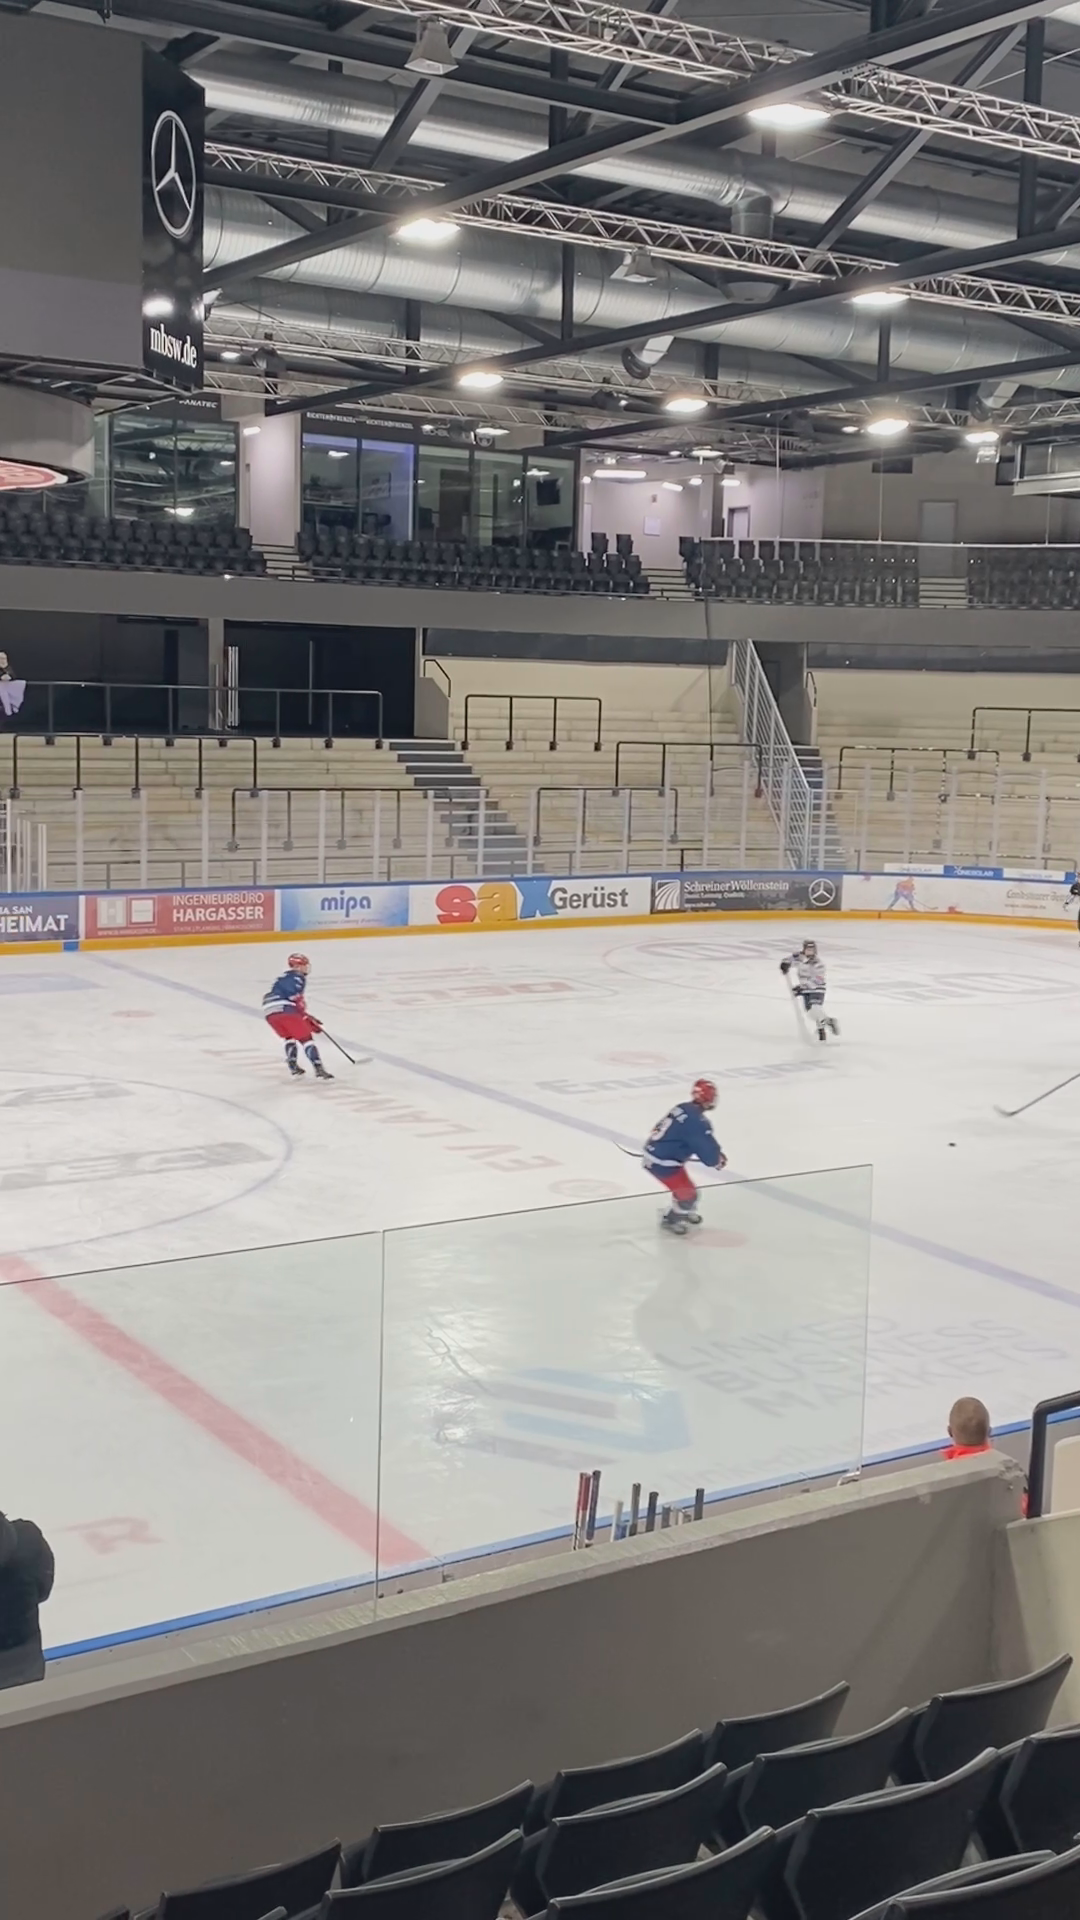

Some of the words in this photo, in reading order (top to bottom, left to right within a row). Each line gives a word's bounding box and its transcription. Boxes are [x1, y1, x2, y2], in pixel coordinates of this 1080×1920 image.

[149, 323, 197, 368] mbsw.de
[12, 905, 33, 914] SAN
[172, 892, 264, 906] INGENIEURBÜRO
[172, 906, 264, 923] HARGASSER
[320, 889, 371, 918] mipa
[435, 879, 559, 924] sax
[550, 886, 629, 910] Gerüst
[533, 1059, 837, 1096] Ensinger
[654, 1316, 899, 1373] LINKED
[695, 1318, 1026, 1394] BUSINESS
[741, 1341, 1069, 1417] MARKETS
